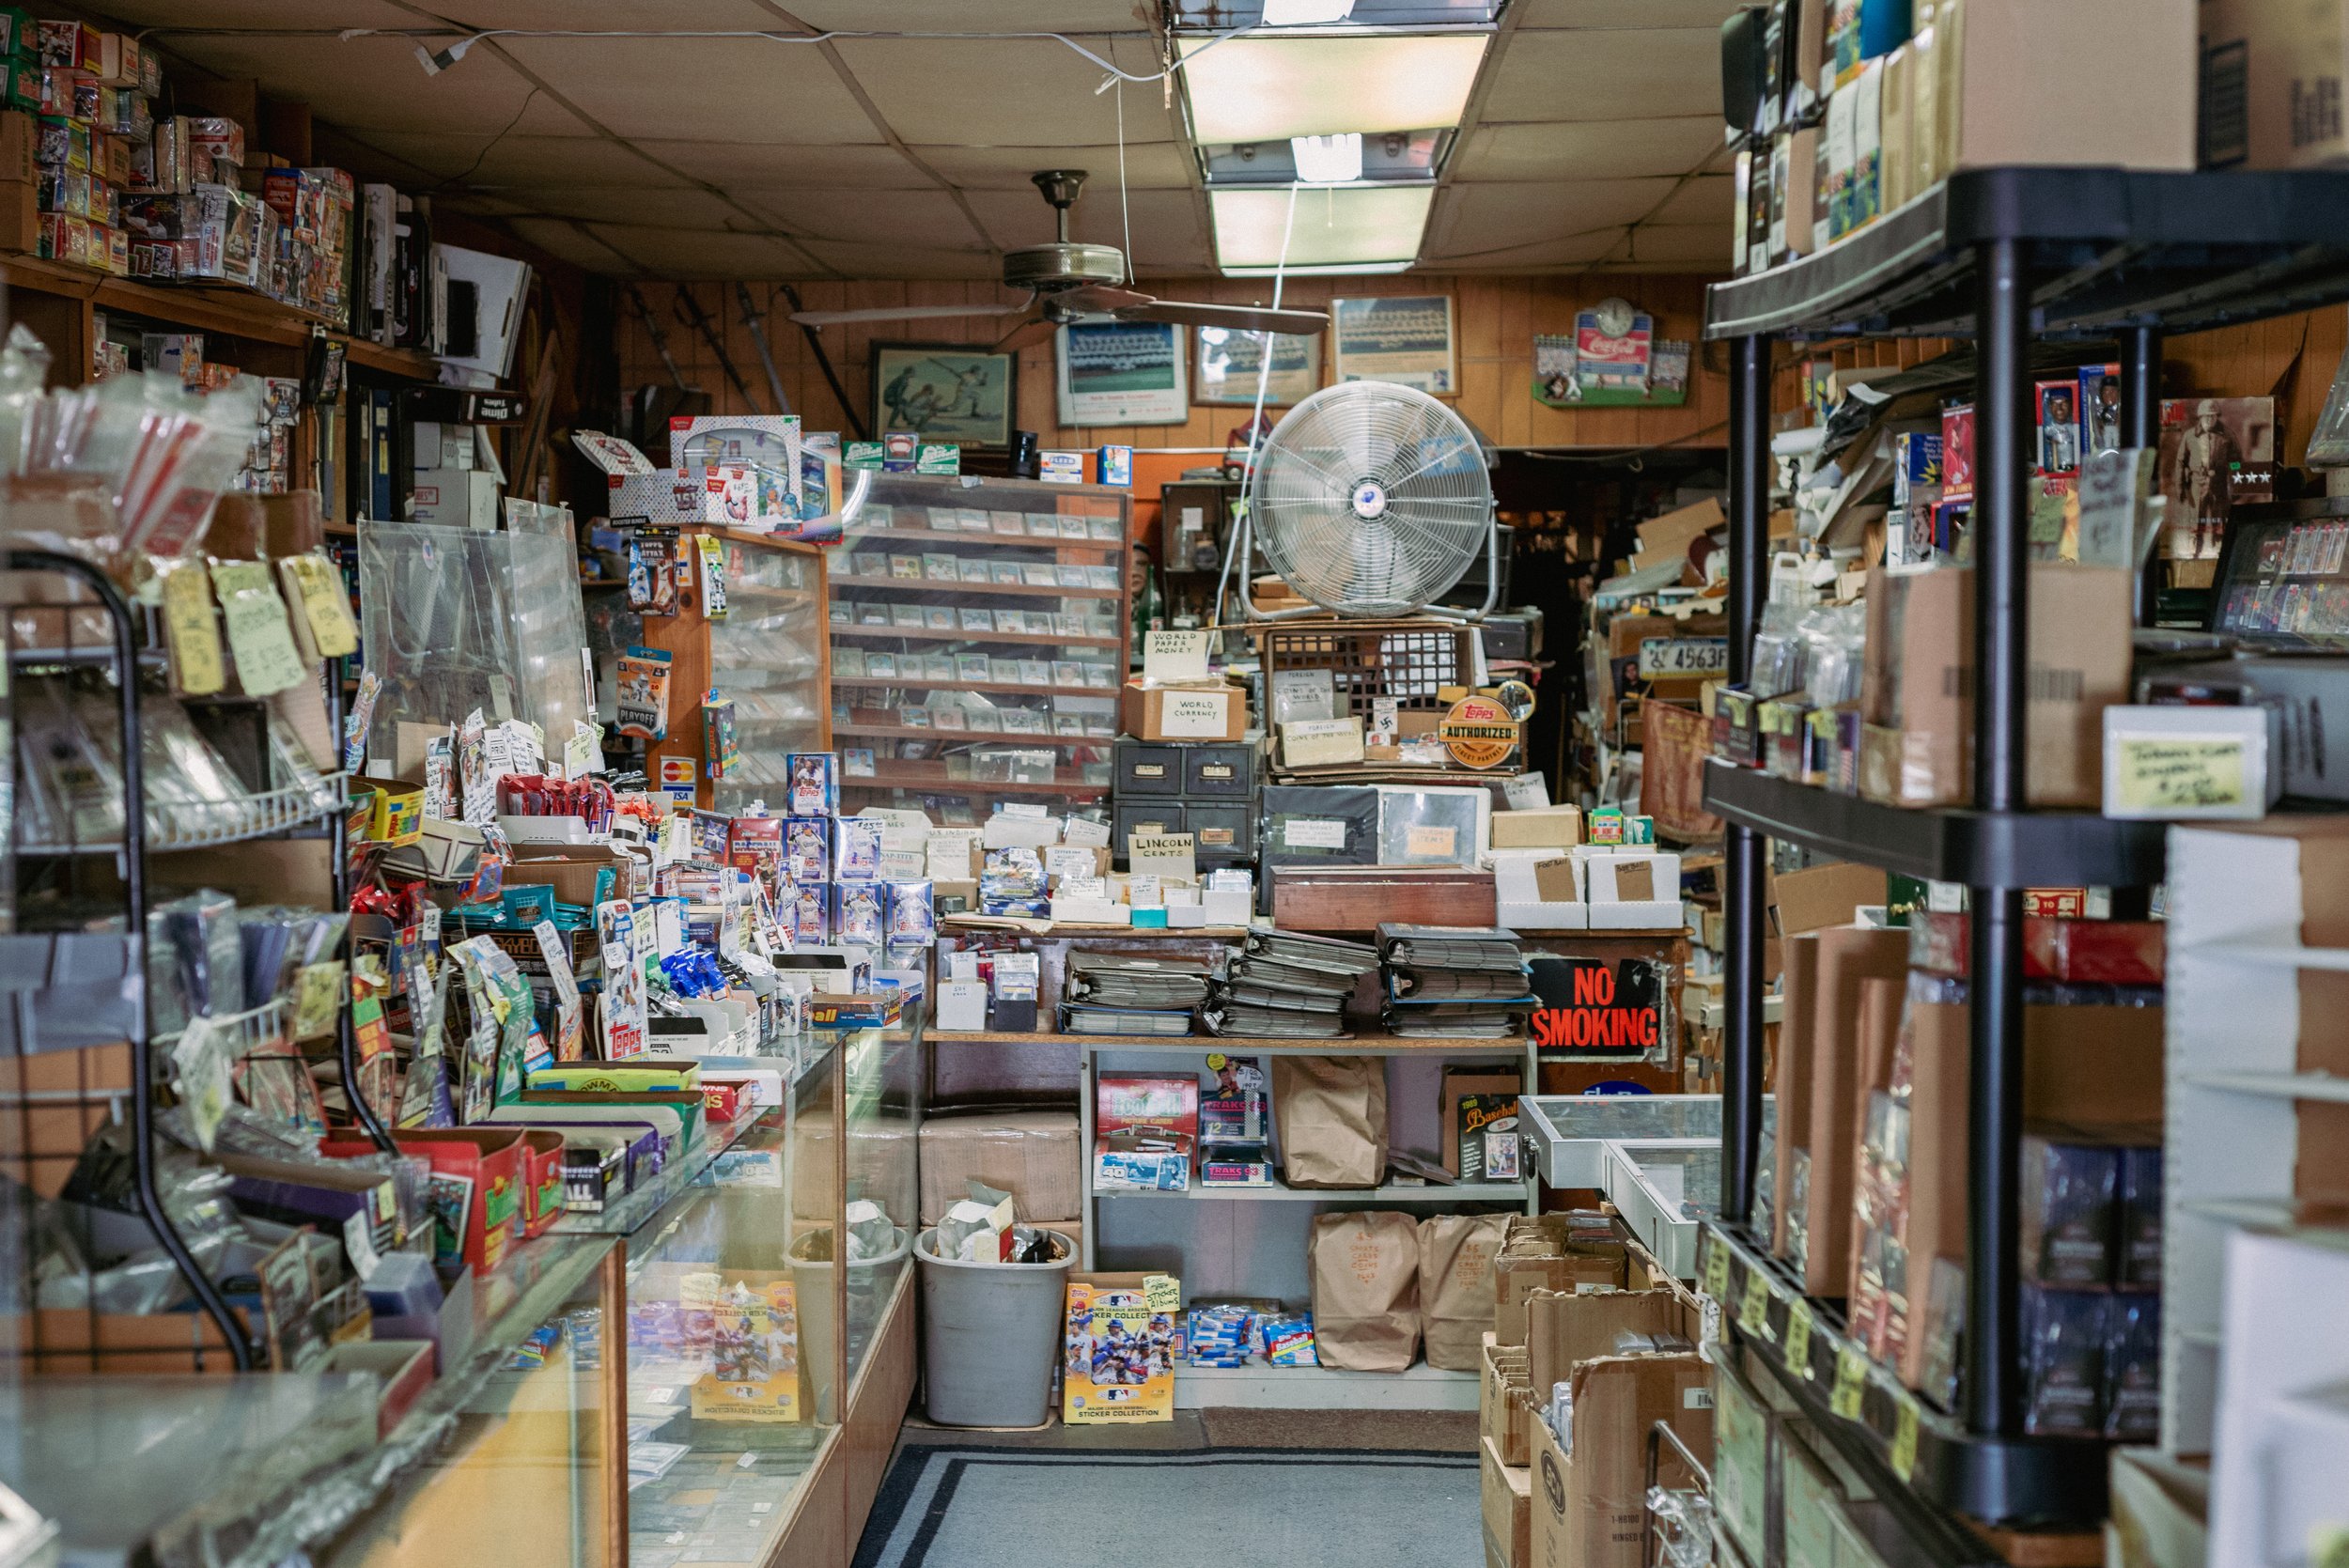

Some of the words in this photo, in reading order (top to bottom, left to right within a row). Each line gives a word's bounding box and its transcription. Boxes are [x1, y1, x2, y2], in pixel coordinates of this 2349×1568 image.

[481, 407, 508, 420] Dime
[1153, 632, 1197, 641] WORLD
[620, 709, 656, 726] PLAYOFF
[1174, 709, 1219, 719] CURRENCY
[1446, 726, 1513, 739] AUTHORIZED
[1454, 744, 1475, 762] DIRECT
[1477, 746, 1503, 763] PARTNER
[1135, 839, 1192, 849] LINCOLN
[1574, 967, 1616, 1006] NO
[1532, 1007, 1658, 1048] SMOKING
[1204, 1100, 1246, 1112] TRAKS
[1462, 1098, 1478, 1110] 1989
[1207, 1122, 1222, 1134] 12
[1207, 1166, 1242, 1176] TRAKS
[1113, 1312, 1150, 1320] COLLECT
[1611, 1532, 1641, 1543] HINGED
